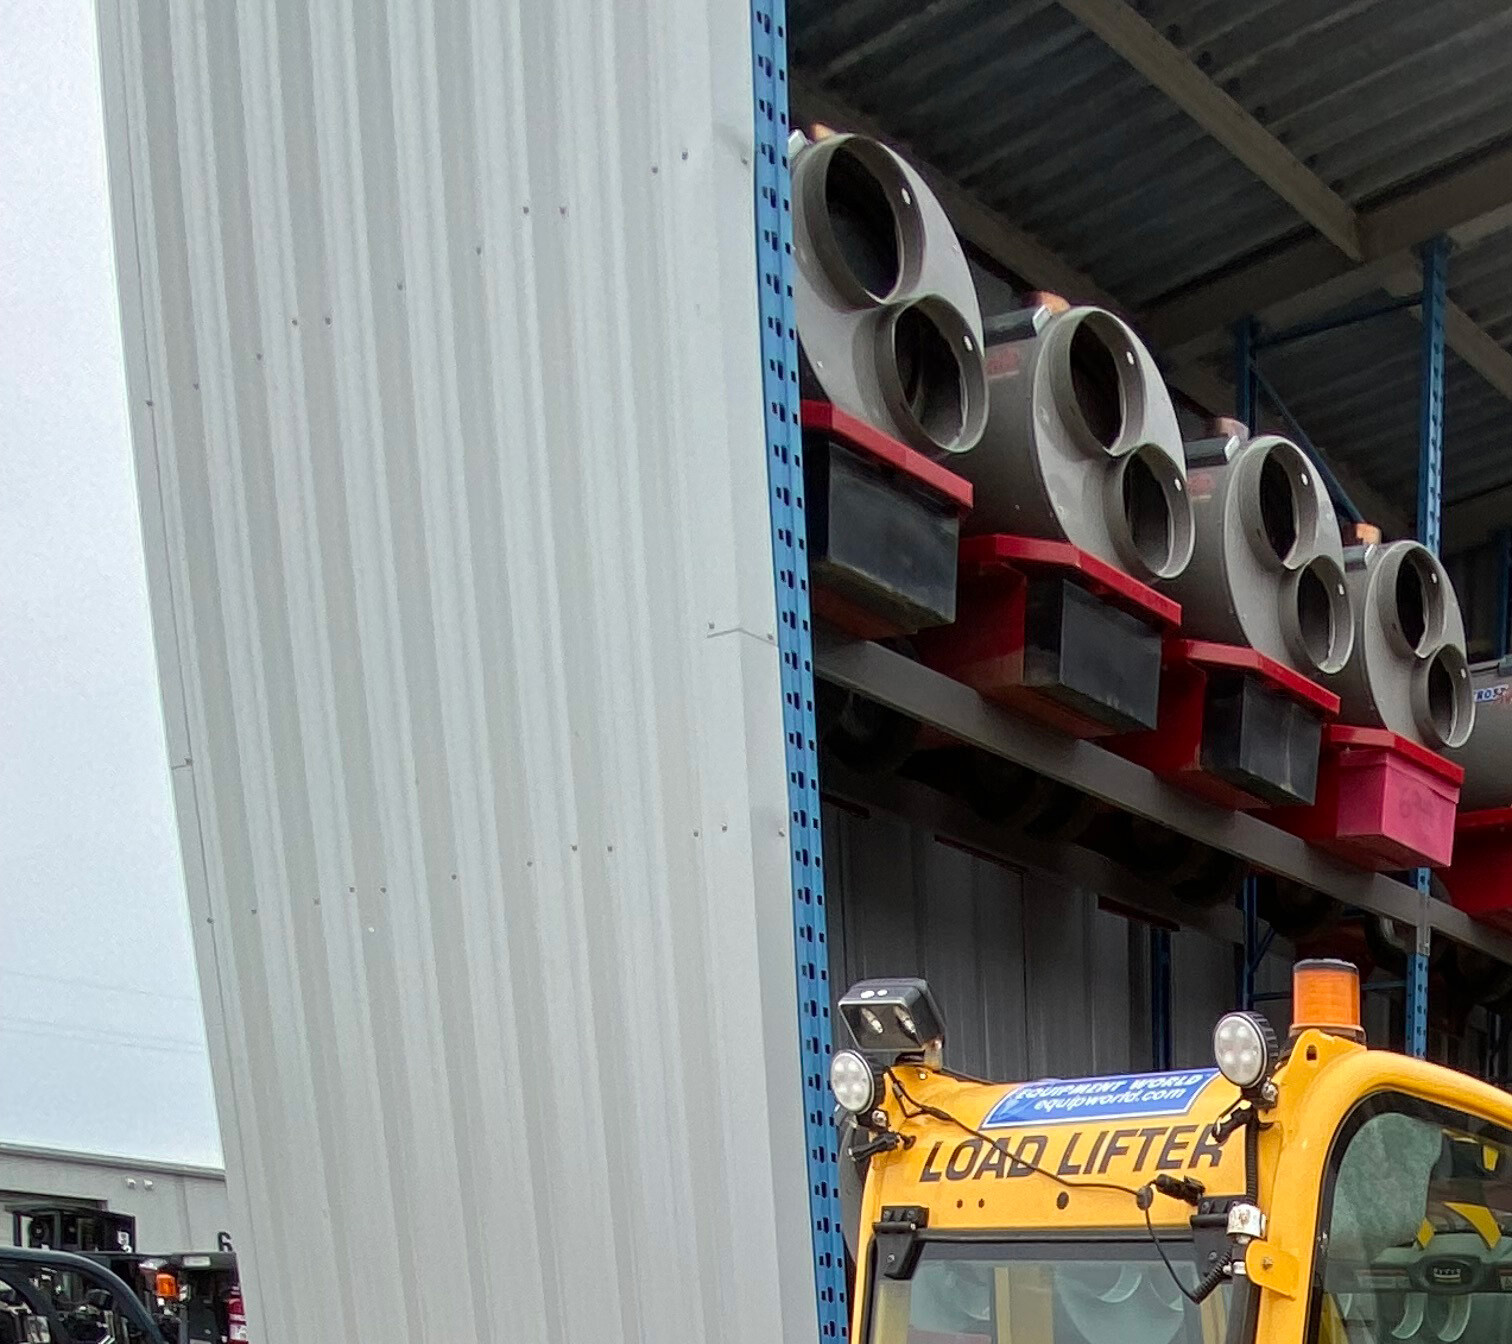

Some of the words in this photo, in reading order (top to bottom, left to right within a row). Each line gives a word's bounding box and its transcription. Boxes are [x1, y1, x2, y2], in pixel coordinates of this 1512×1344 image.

[1015, 1079, 1128, 1101] EQUIPMENT
[1129, 1072, 1204, 1090] WORLD
[1033, 1087, 1188, 1114] equipworld.com
[919, 1134, 1049, 1184] LOAD
[1056, 1122, 1226, 1178] LIFTER
